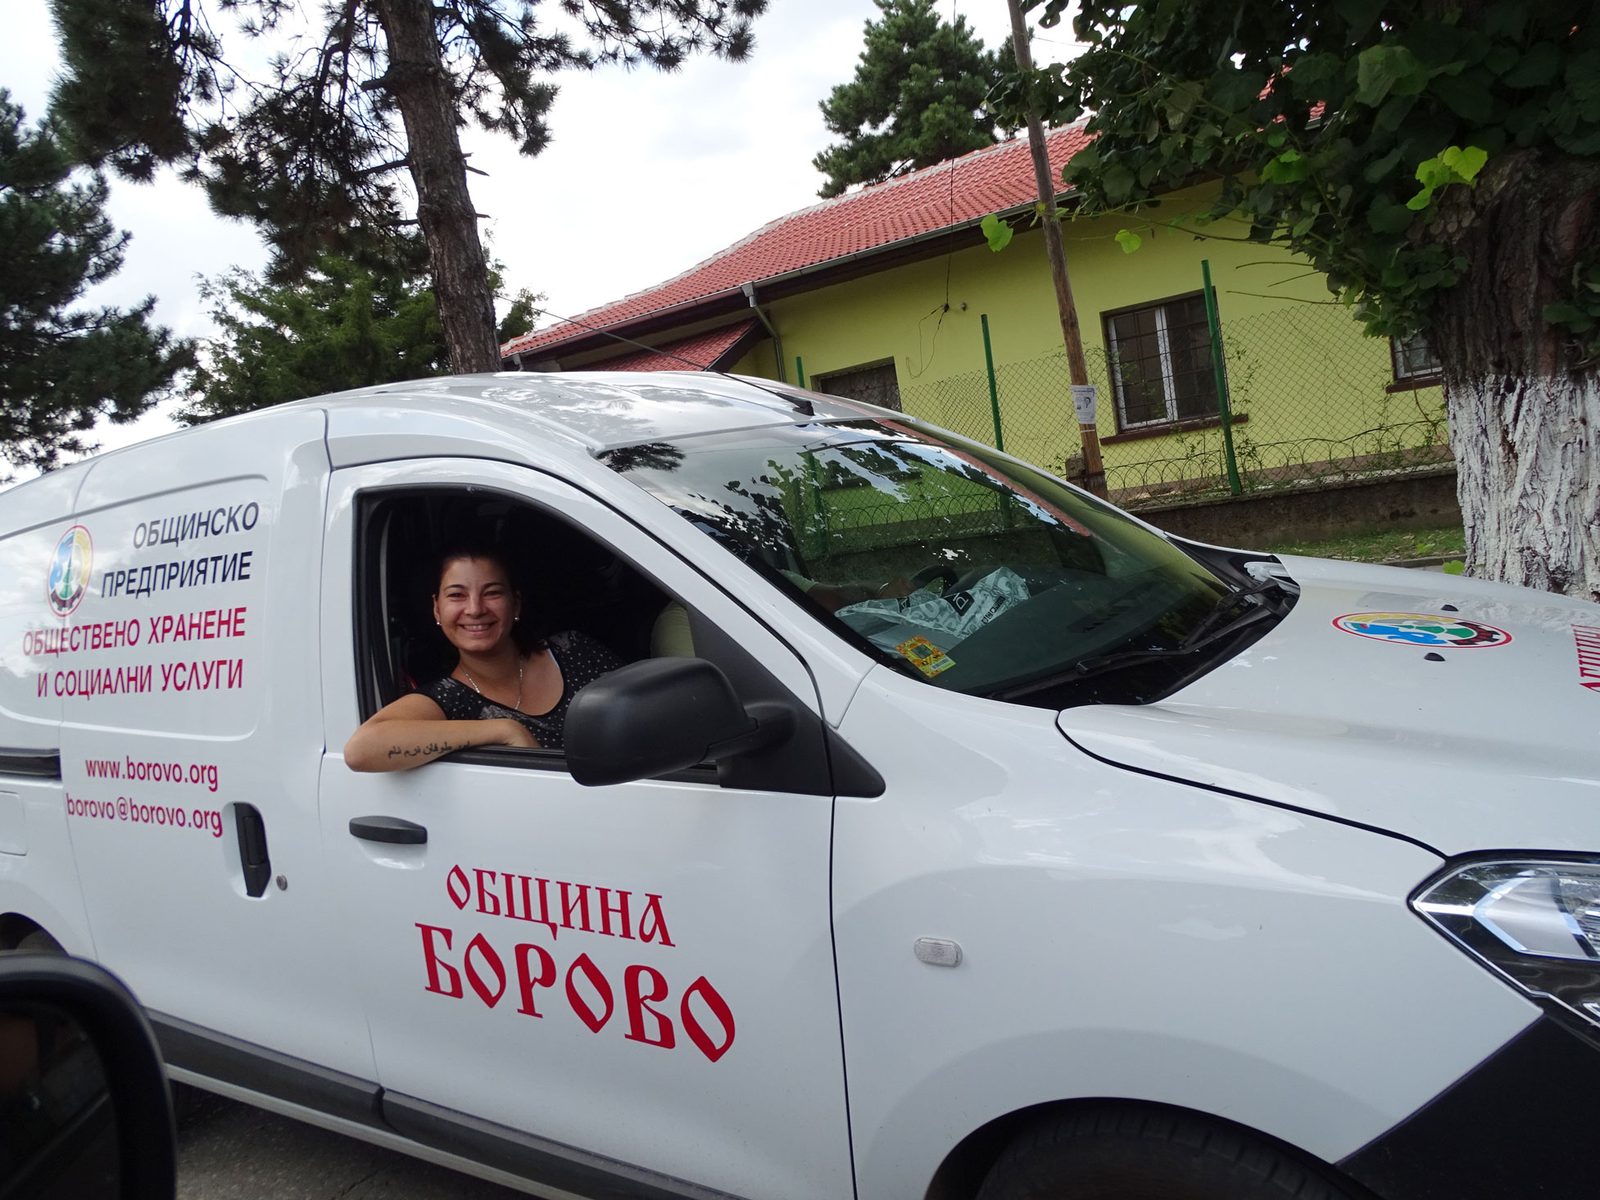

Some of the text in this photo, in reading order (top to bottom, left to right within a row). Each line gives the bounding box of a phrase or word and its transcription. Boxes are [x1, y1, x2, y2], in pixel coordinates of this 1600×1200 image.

[134, 502, 260, 549] ОБЩИНСКО
[101, 551, 253, 598] ПРЕДПРИЯТИЕ
[23, 606, 247, 657] ОБЩЕСТВЕНО ХРАНЕНЕ
[37, 658, 243, 700] И СОЦИАЛНИ УСЛУГИ
[85, 756, 218, 792] www.borovo.org
[66, 793, 223, 837] borovo@borovo.org
[446, 864, 676, 947] ОБЩИНА
[415, 922, 736, 1063] БОРОВО
